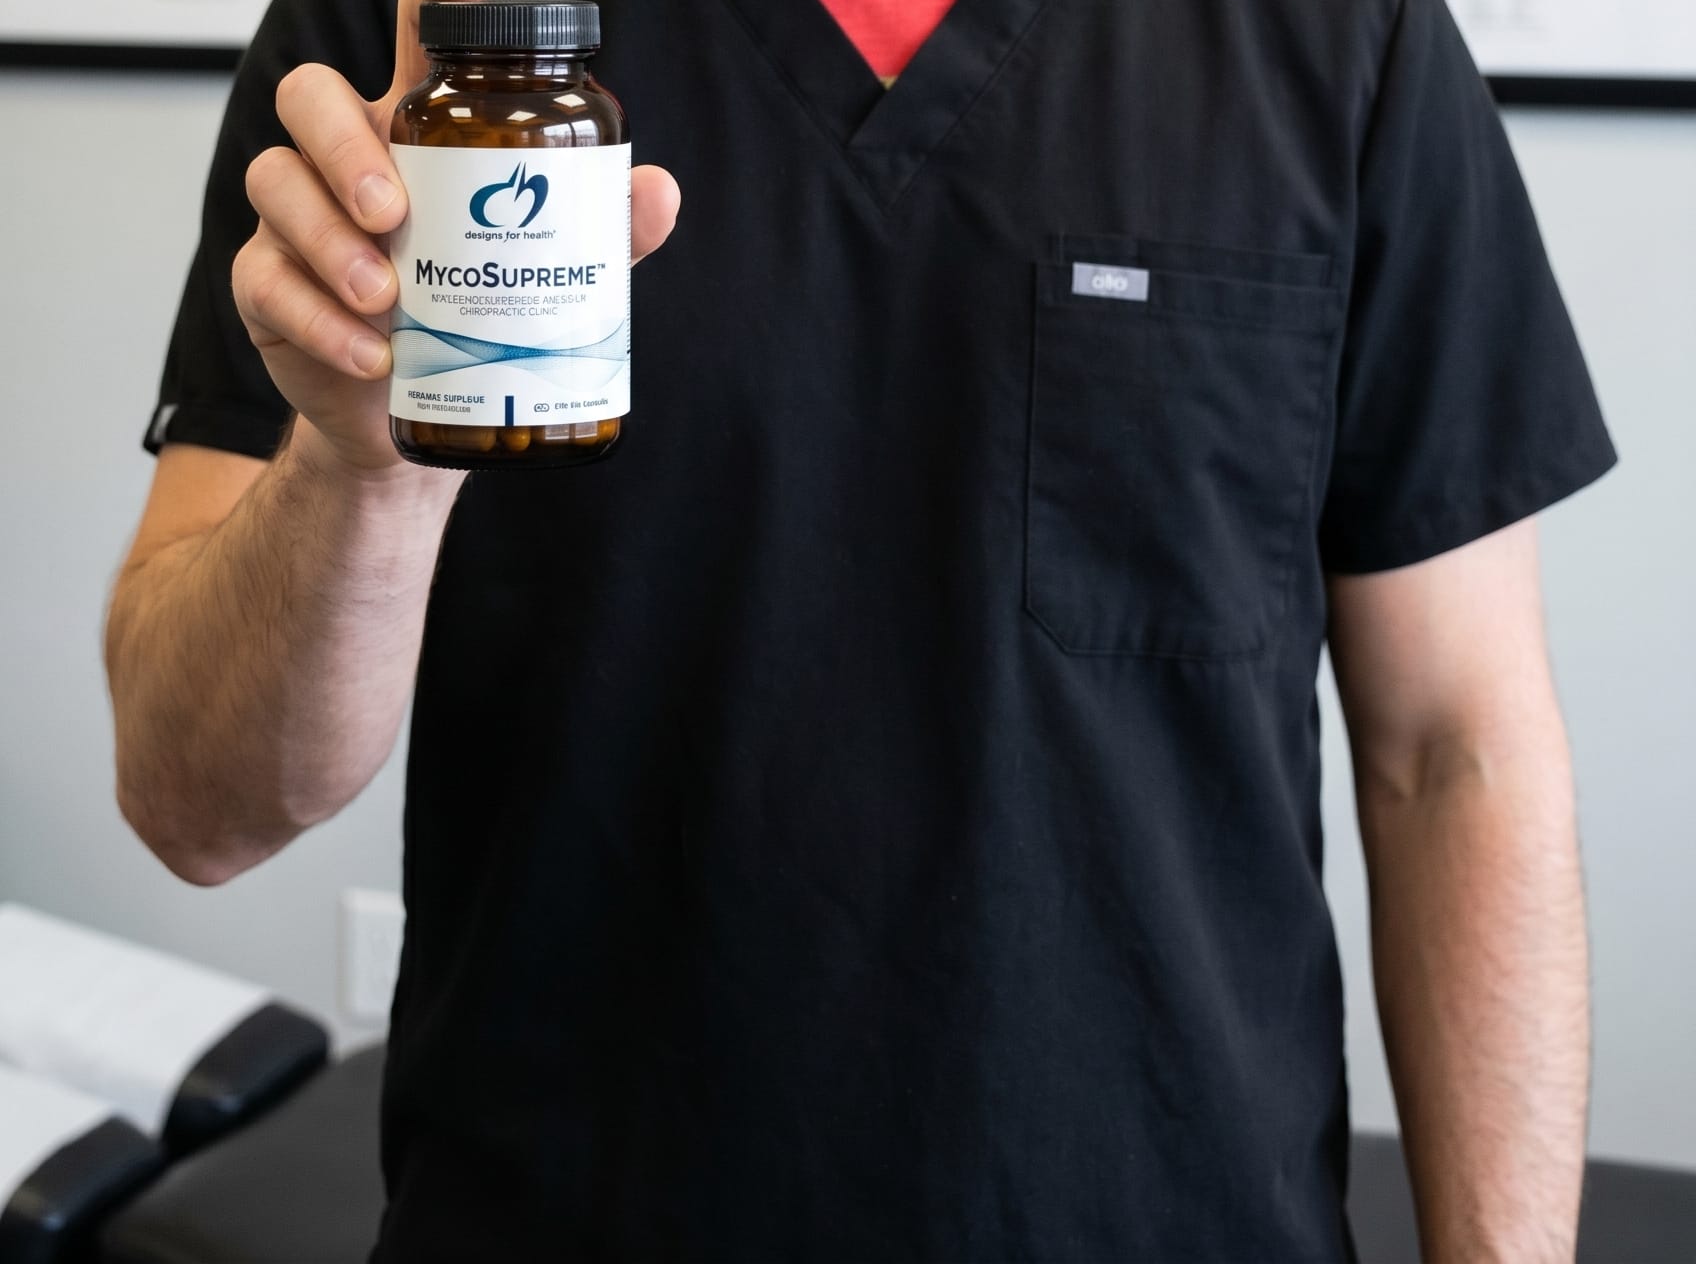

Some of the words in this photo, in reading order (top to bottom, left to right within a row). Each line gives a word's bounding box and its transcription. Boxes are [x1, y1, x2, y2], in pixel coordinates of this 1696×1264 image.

[465, 230, 503, 241] designs
[504, 231, 520, 243] for
[460, 306, 526, 317] CHIROPRACTIC
[528, 306, 558, 316] CLINIC
